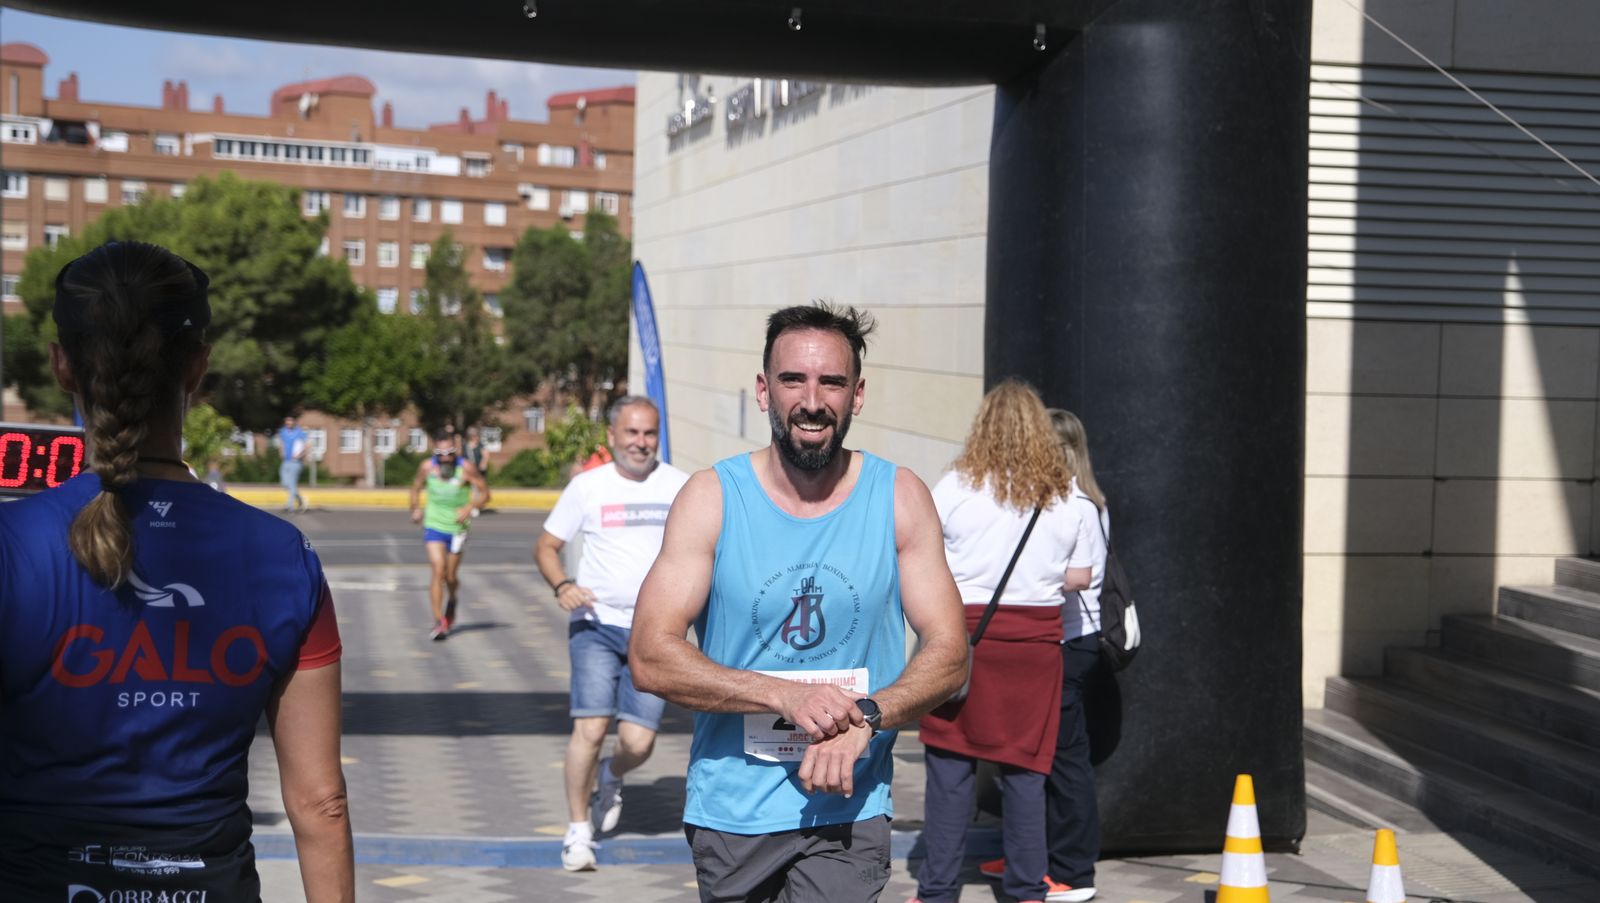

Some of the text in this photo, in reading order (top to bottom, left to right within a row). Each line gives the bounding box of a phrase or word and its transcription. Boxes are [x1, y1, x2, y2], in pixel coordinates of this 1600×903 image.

[763, 571, 783, 588] TEAM
[822, 563, 848, 584] BOXING
[751, 597, 761, 625] BOXING
[852, 593, 861, 613] TEAM
[51, 619, 269, 689] GALO
[773, 653, 795, 664] TEAM
[808, 647, 838, 662] BOXING
[117, 691, 201, 708] SPORT
